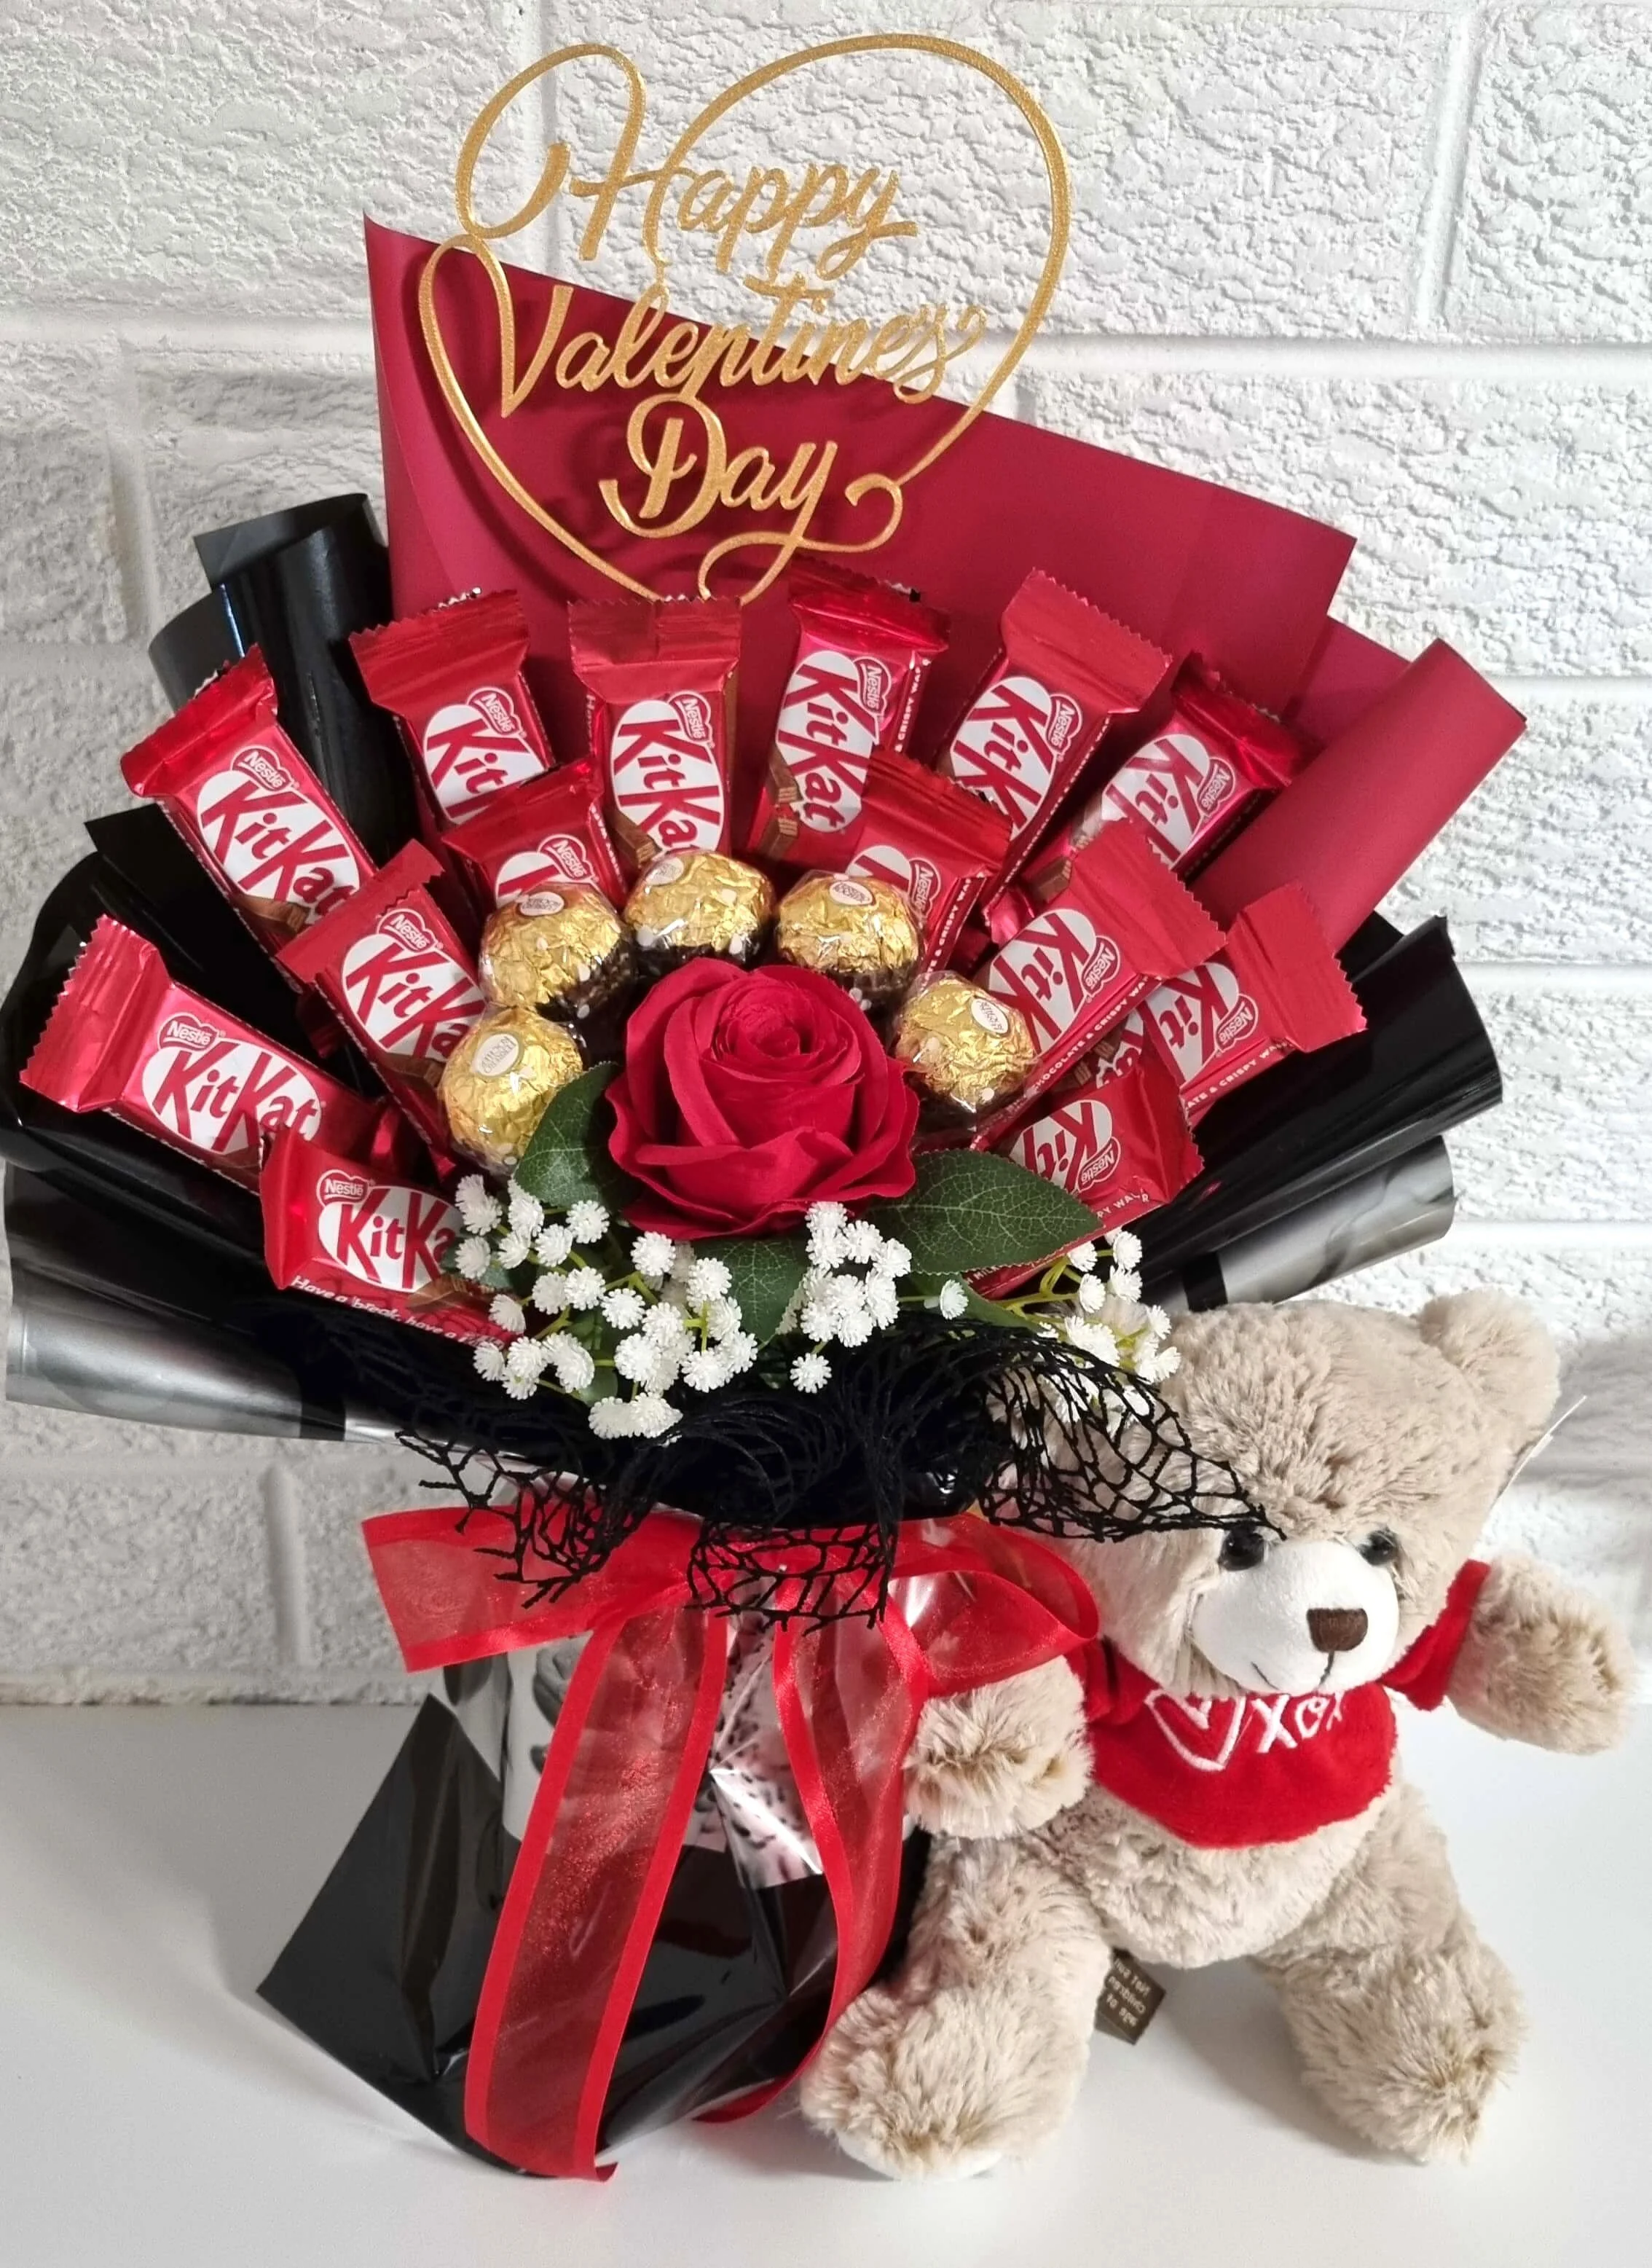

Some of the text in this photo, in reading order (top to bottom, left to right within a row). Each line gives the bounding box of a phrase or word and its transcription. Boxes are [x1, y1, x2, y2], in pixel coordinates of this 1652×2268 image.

[568, 95, 918, 284] Happy
[597, 397, 839, 543] Day
[613, 719, 721, 855] KitKa
[778, 664, 875, 828] KitKat
[1219, 1059, 1257, 1088] CRISPY
